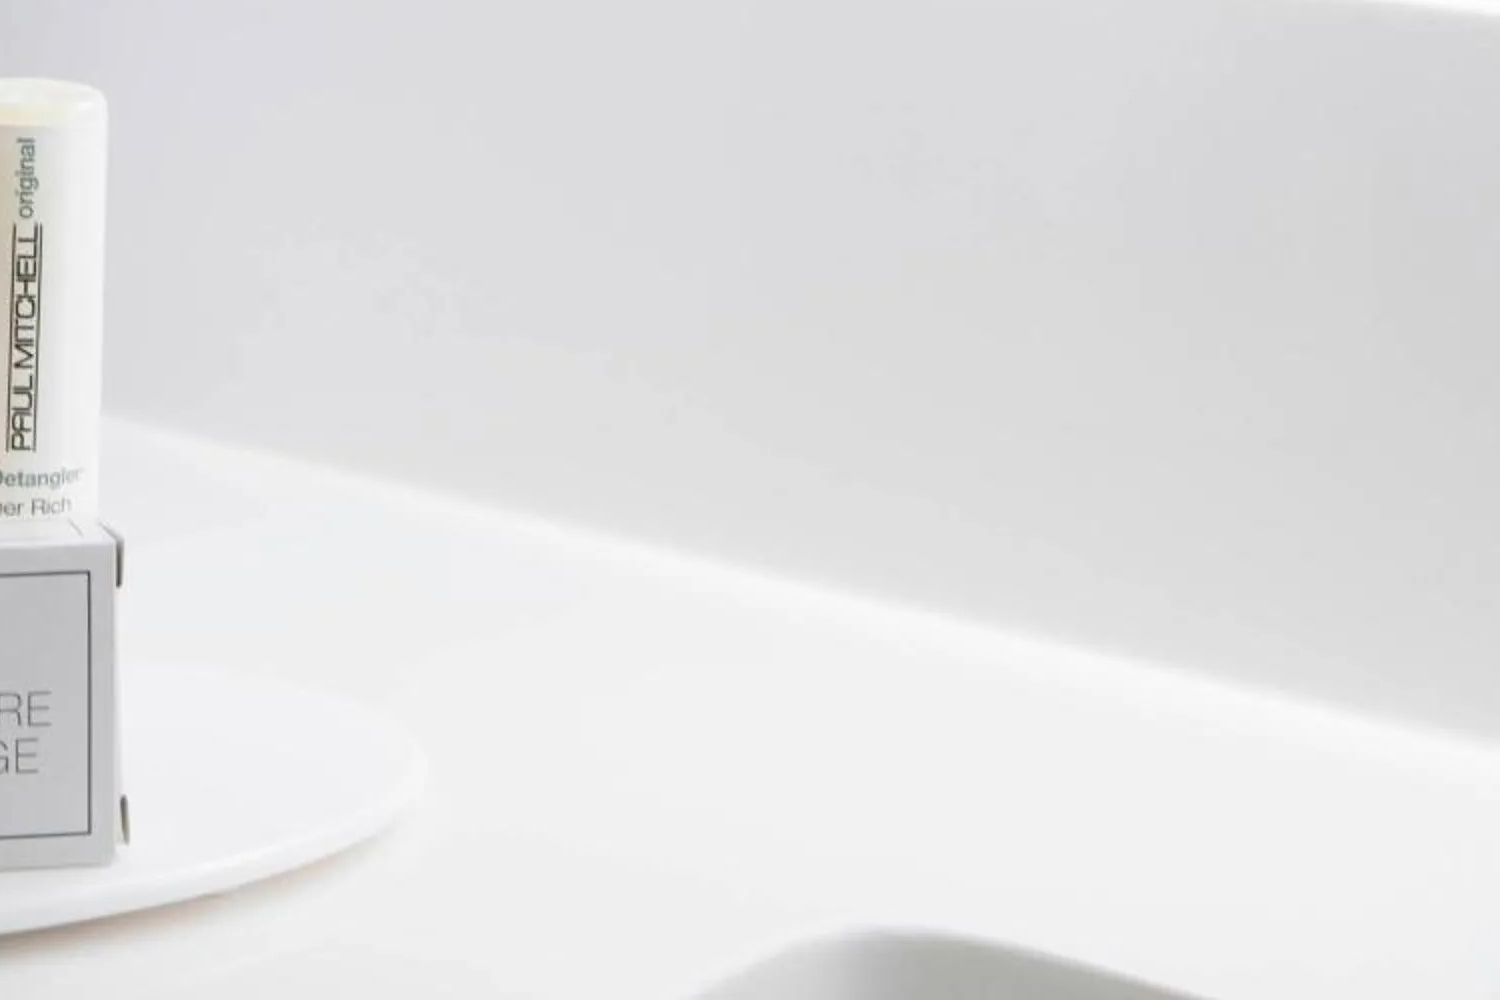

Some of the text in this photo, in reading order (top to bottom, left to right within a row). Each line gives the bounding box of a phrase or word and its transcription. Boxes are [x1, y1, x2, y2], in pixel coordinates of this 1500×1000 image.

[11, 137, 40, 452] PAUL MITCHELL original
[30, 496, 73, 517] Rich
